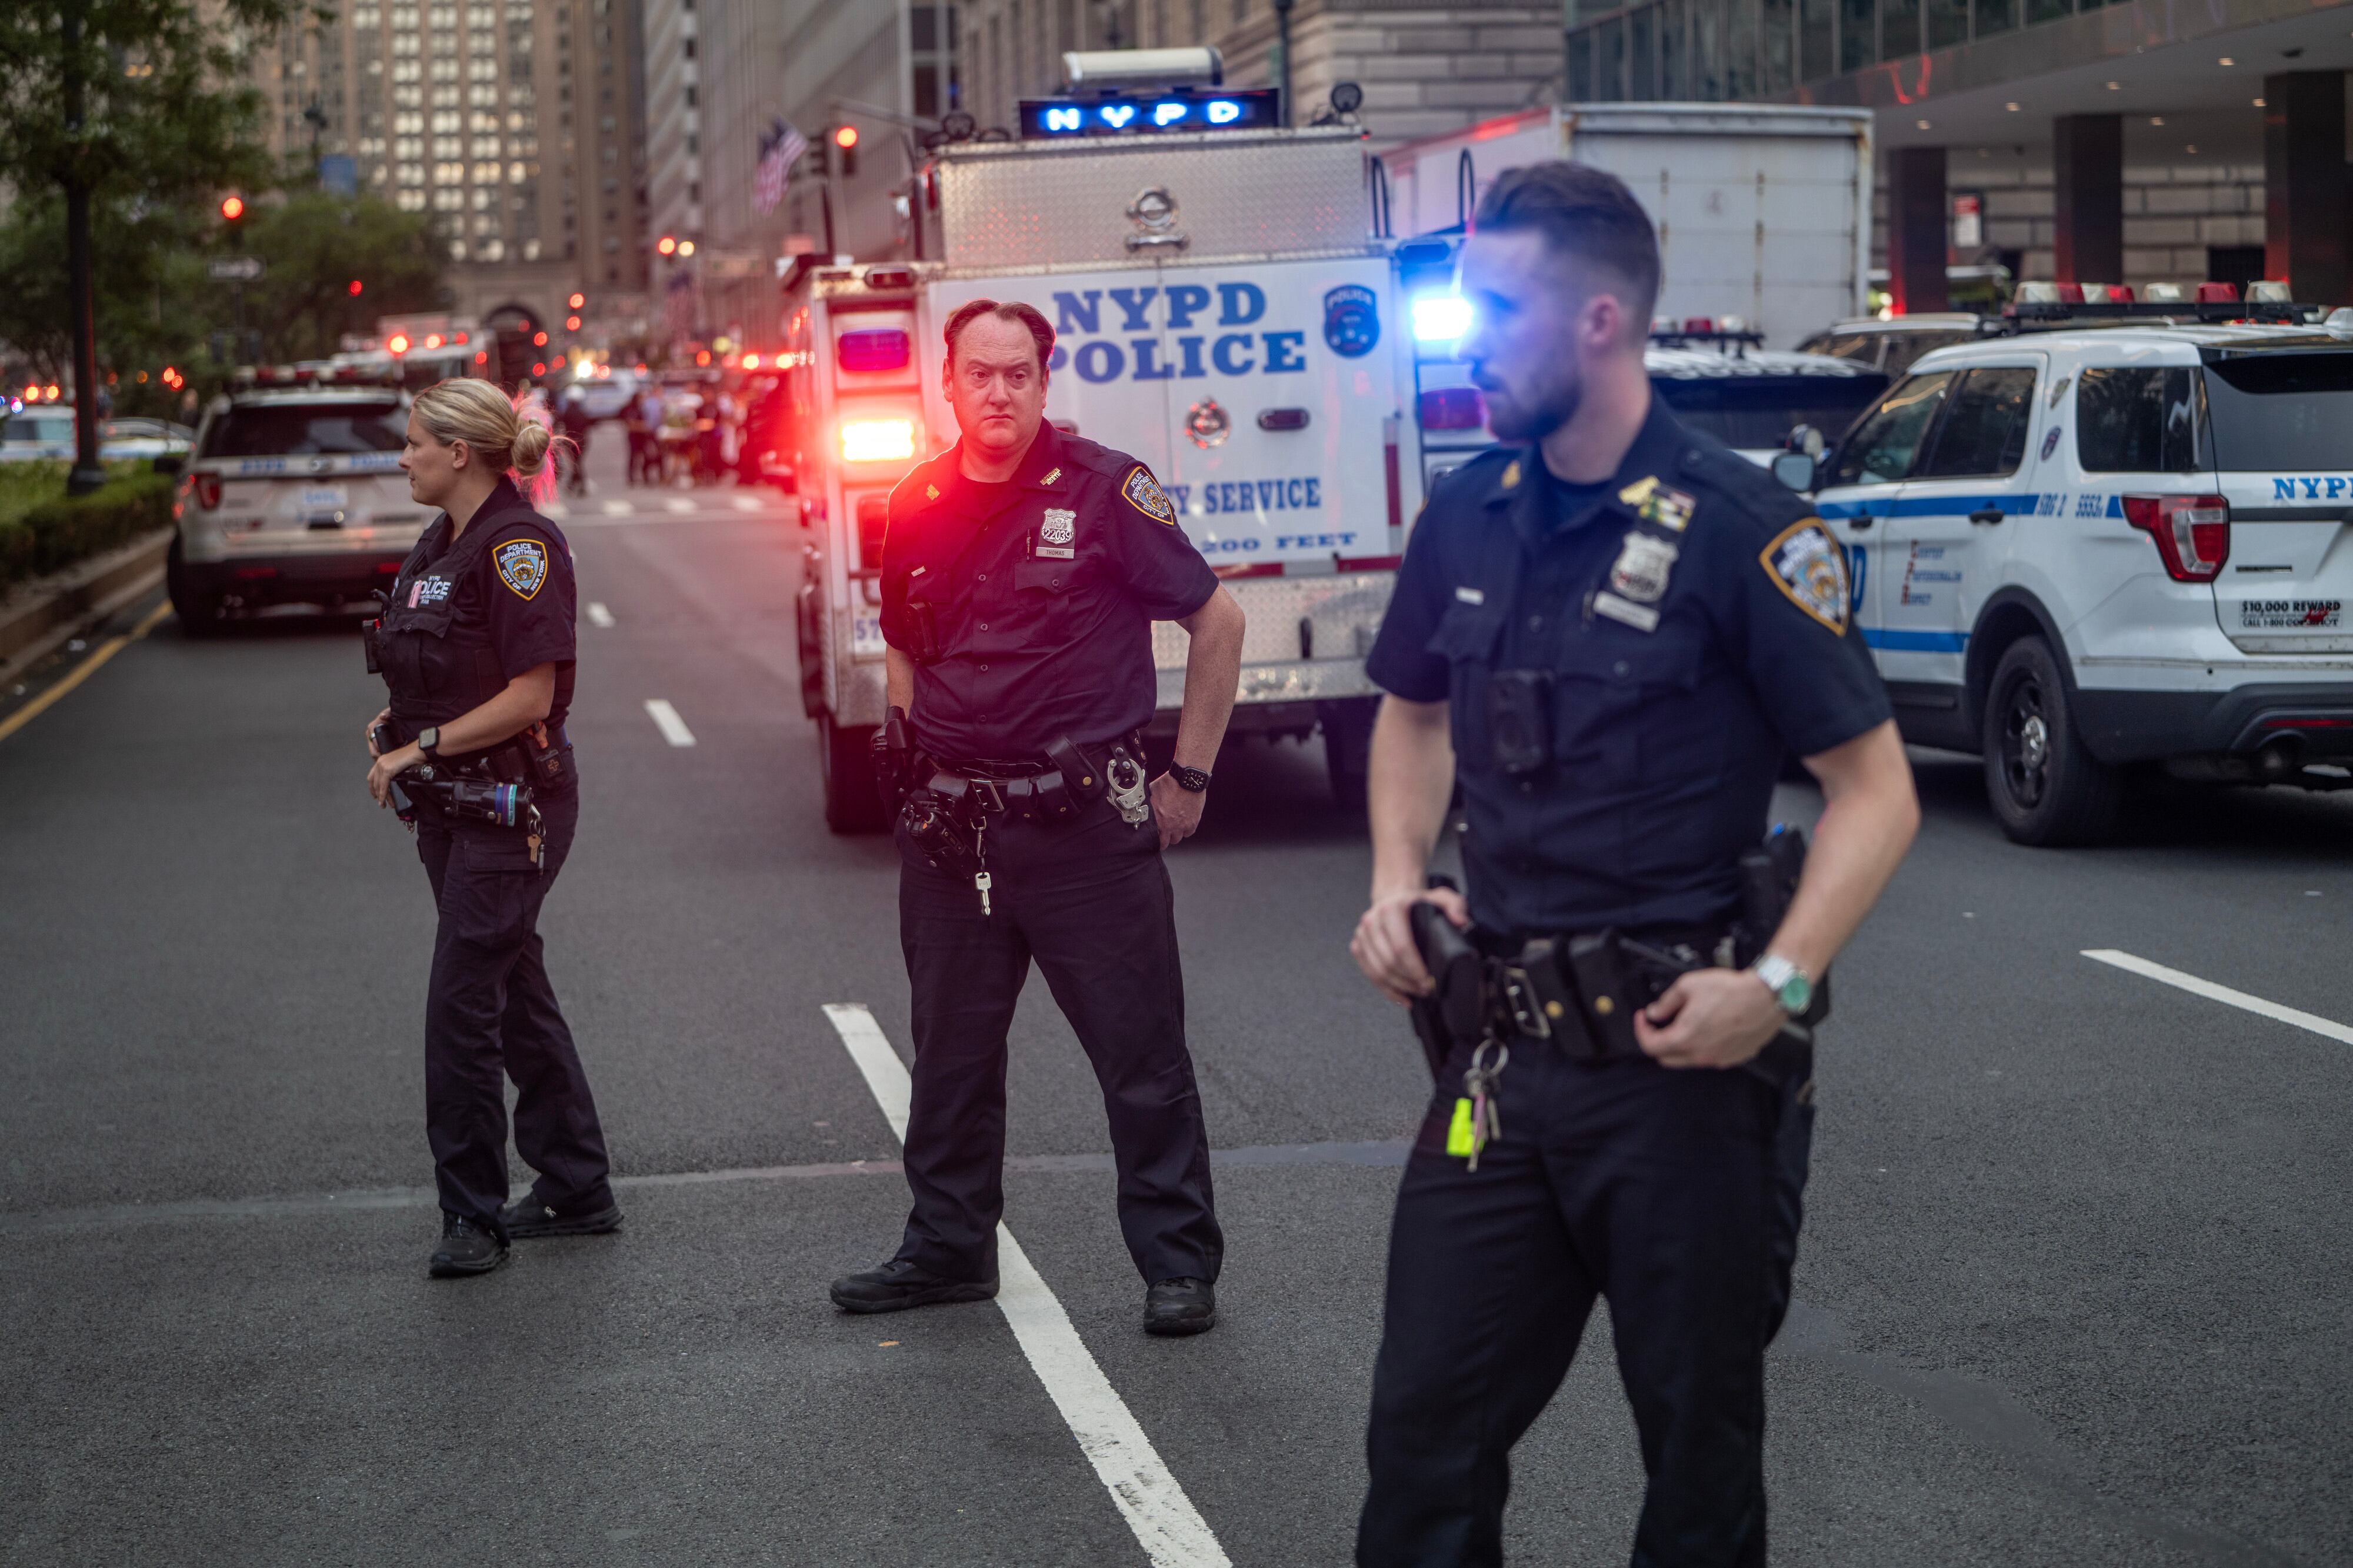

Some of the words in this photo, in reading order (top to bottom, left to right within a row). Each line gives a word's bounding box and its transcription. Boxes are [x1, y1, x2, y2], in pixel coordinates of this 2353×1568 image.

[1047, 101, 1239, 131] NYPD
[1052, 282, 1267, 335] NYPD
[1040, 467, 1060, 485] MIDTOWN
[1047, 472, 1061, 485] NORTH
[1131, 472, 1144, 488] POLICE
[1132, 475, 1151, 500] DEPARTMENT
[1204, 477, 1321, 514] SERVICE
[1143, 505, 1156, 515] CITY
[1044, 529, 1071, 541] 22039
[1202, 537, 1260, 553] 200
[1275, 532, 1357, 550] FEET
[507, 543, 532, 552] POLICE
[500, 549, 541, 563] DEPARTMENT
[502, 569, 514, 583] CITY
[512, 582, 522, 590] OF
[530, 577, 541, 591] NEW
[2242, 600, 2289, 616] $10,000
[2292, 600, 2341, 612] REWARD
[2242, 618, 2261, 628] CALL
